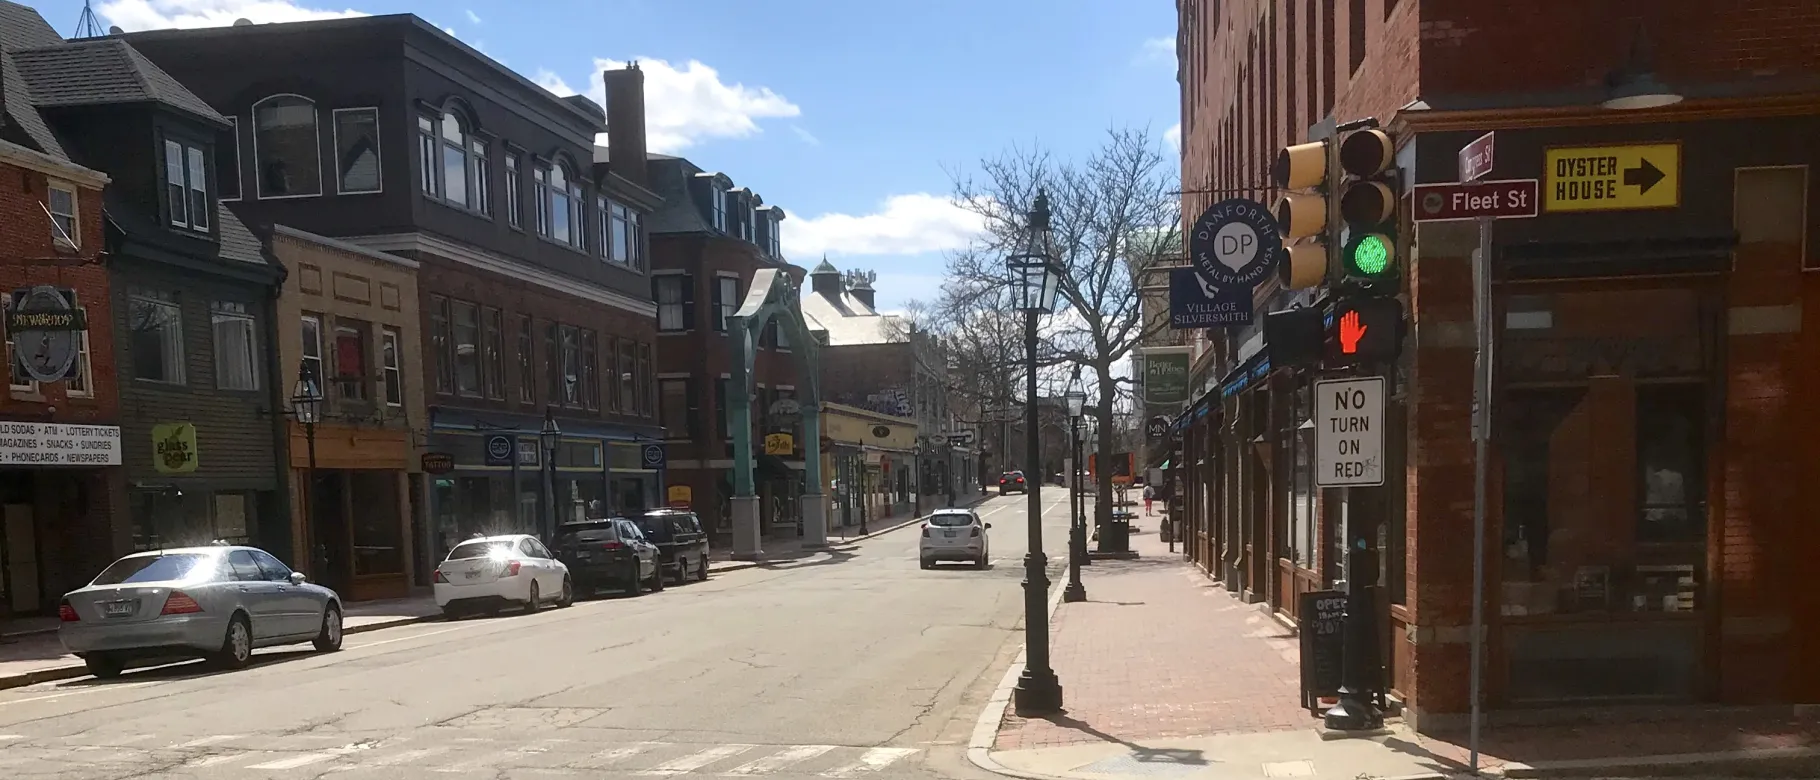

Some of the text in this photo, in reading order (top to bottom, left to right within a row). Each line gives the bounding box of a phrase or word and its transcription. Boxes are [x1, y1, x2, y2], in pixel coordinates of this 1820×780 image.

[1484, 143, 1491, 164] St
[1556, 156, 1618, 178] OYSTER
[1556, 179, 1617, 201] HOUSE
[1452, 189, 1527, 211] Fleet St
[1198, 204, 1273, 241] DANFORTH
[1222, 234, 1253, 255] DP
[1199, 246, 1274, 284] METAL BY HAND USA
[1186, 302, 1237, 313] VILLAGE
[1174, 312, 1249, 324] SILVERSMITH
[1149, 360, 1173, 369] Better
[1335, 389, 1366, 411] NO
[11, 424, 35, 435] SODAS
[44, 426, 58, 435] ATM
[66, 426, 93, 436] LOTTERY
[94, 428, 120, 438] TICKETS
[1149, 424, 1166, 433] MN
[1330, 416, 1369, 433] TURN
[46, 440, 74, 449] SNACKS
[81, 440, 112, 450] SUNDRIES
[157, 438, 188, 454] glass
[1339, 439, 1360, 455] ON
[11, 452, 59, 462] PHONECARDS
[66, 453, 109, 463] NEWSPAPERS
[163, 451, 194, 466] pear
[424, 461, 452, 469] TATTOO
[1335, 461, 1364, 478] RED
